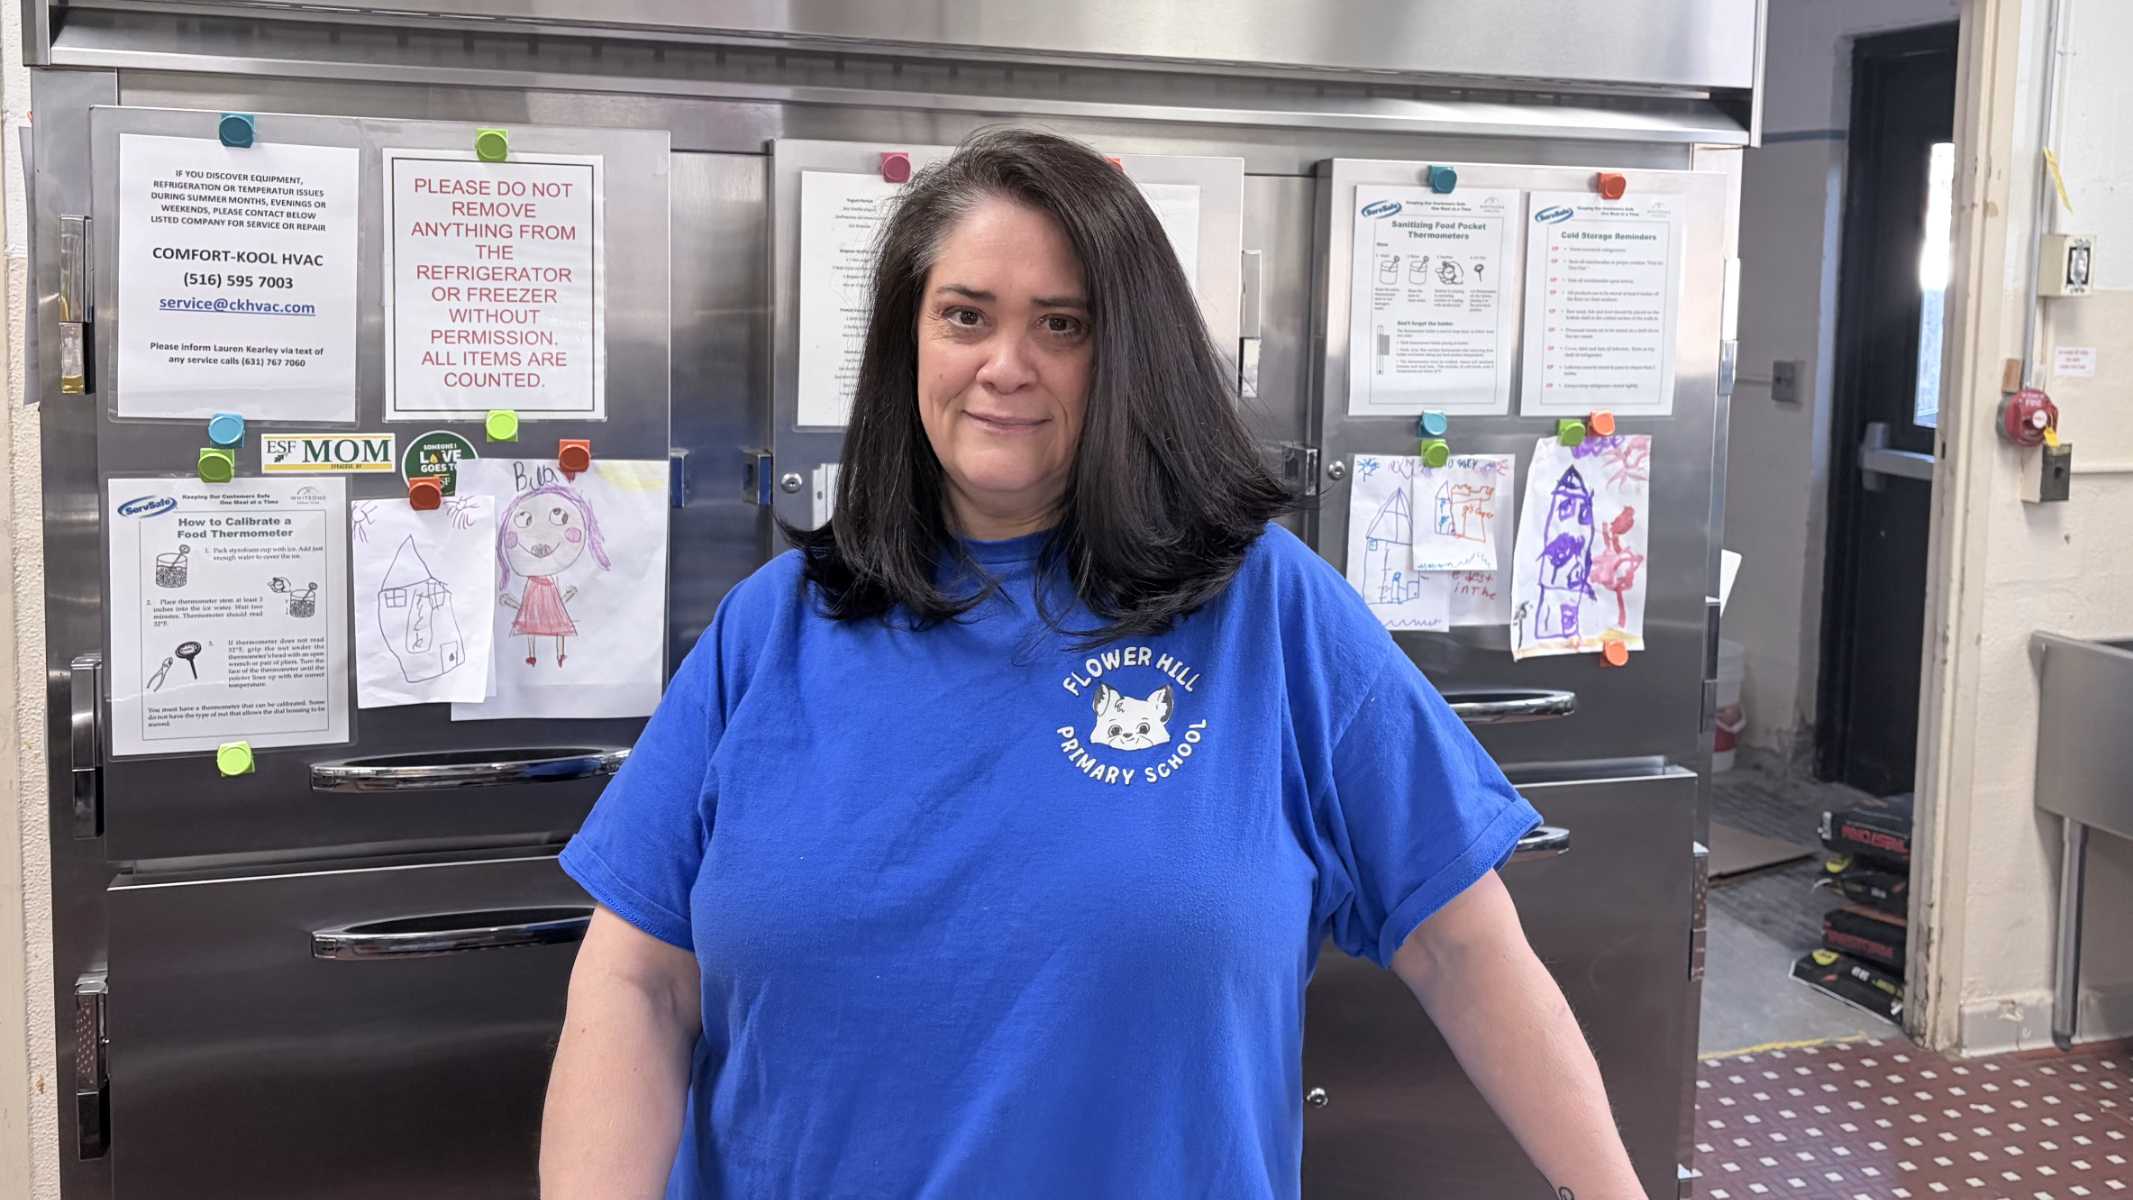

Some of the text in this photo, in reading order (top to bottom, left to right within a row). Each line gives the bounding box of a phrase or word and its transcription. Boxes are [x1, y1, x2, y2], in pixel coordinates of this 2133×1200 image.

[206, 172, 249, 181] DISCOVER
[250, 175, 304, 185] EQUIPMENT,
[153, 181, 221, 191] REFRIGERATION
[238, 185, 294, 195] TEMPERATUR
[296, 189, 324, 197] ISSUES
[415, 178, 573, 198] PLEASE DO NOT
[151, 192, 186, 201] DURING
[187, 194, 227, 203] SUMMER
[228, 196, 269, 206] MONTHS,
[270, 199, 312, 207] EVENINGS
[161, 205, 317, 219] WEEKENDS, PLEASE CONTACT BELOW
[452, 201, 536, 218] REMOVE
[151, 216, 179, 224] LISTED
[181, 217, 226, 226] COMPANY
[246, 221, 280, 229] SERVICE
[282, 222, 295, 230] OR
[296, 223, 326, 231] REPAIR
[411, 222, 576, 240] ANYTHING FROM
[1391, 221, 1486, 230] Sanitizing Food Pocket
[1408, 231, 1469, 239] Thermometers
[1561, 231, 1580, 239] Cold
[1581, 232, 1613, 241] Storage
[153, 248, 323, 266] COMFORT-KOOL HVAC
[475, 244, 514, 260] THE
[184, 272, 293, 289] (516) 595 7003
[417, 265, 572, 282] REFRIGERATOR
[431, 286, 557, 303] OR FREEZER
[159, 298, 316, 316] service@ckhvac.com
[449, 309, 541, 324] WITHOUT
[431, 330, 558, 345] PERMISSION.
[150, 342, 179, 350] Please
[181, 343, 211, 351] inform
[246, 346, 278, 355] Kearley
[314, 347, 324, 355] of
[220, 357, 240, 365] calls
[241, 357, 264, 367] (631)
[267, 358, 282, 366] 767
[285, 359, 306, 367] 7060
[421, 351, 567, 367] ALL ITEMS ARE
[444, 372, 545, 387] COUNTED.
[266, 439, 391, 463] ESF MOM
[420, 464, 447, 473] GOES
[125, 498, 171, 516] ServSafe
[178, 518, 206, 526] How
[209, 518, 222, 526] to
[225, 517, 281, 526] Calibrate
[177, 529, 294, 538] Food Thermometer
[1062, 647, 1200, 697] FLOWER HILL
[1056, 719, 1208, 785] PRIMARY SCHOOL
